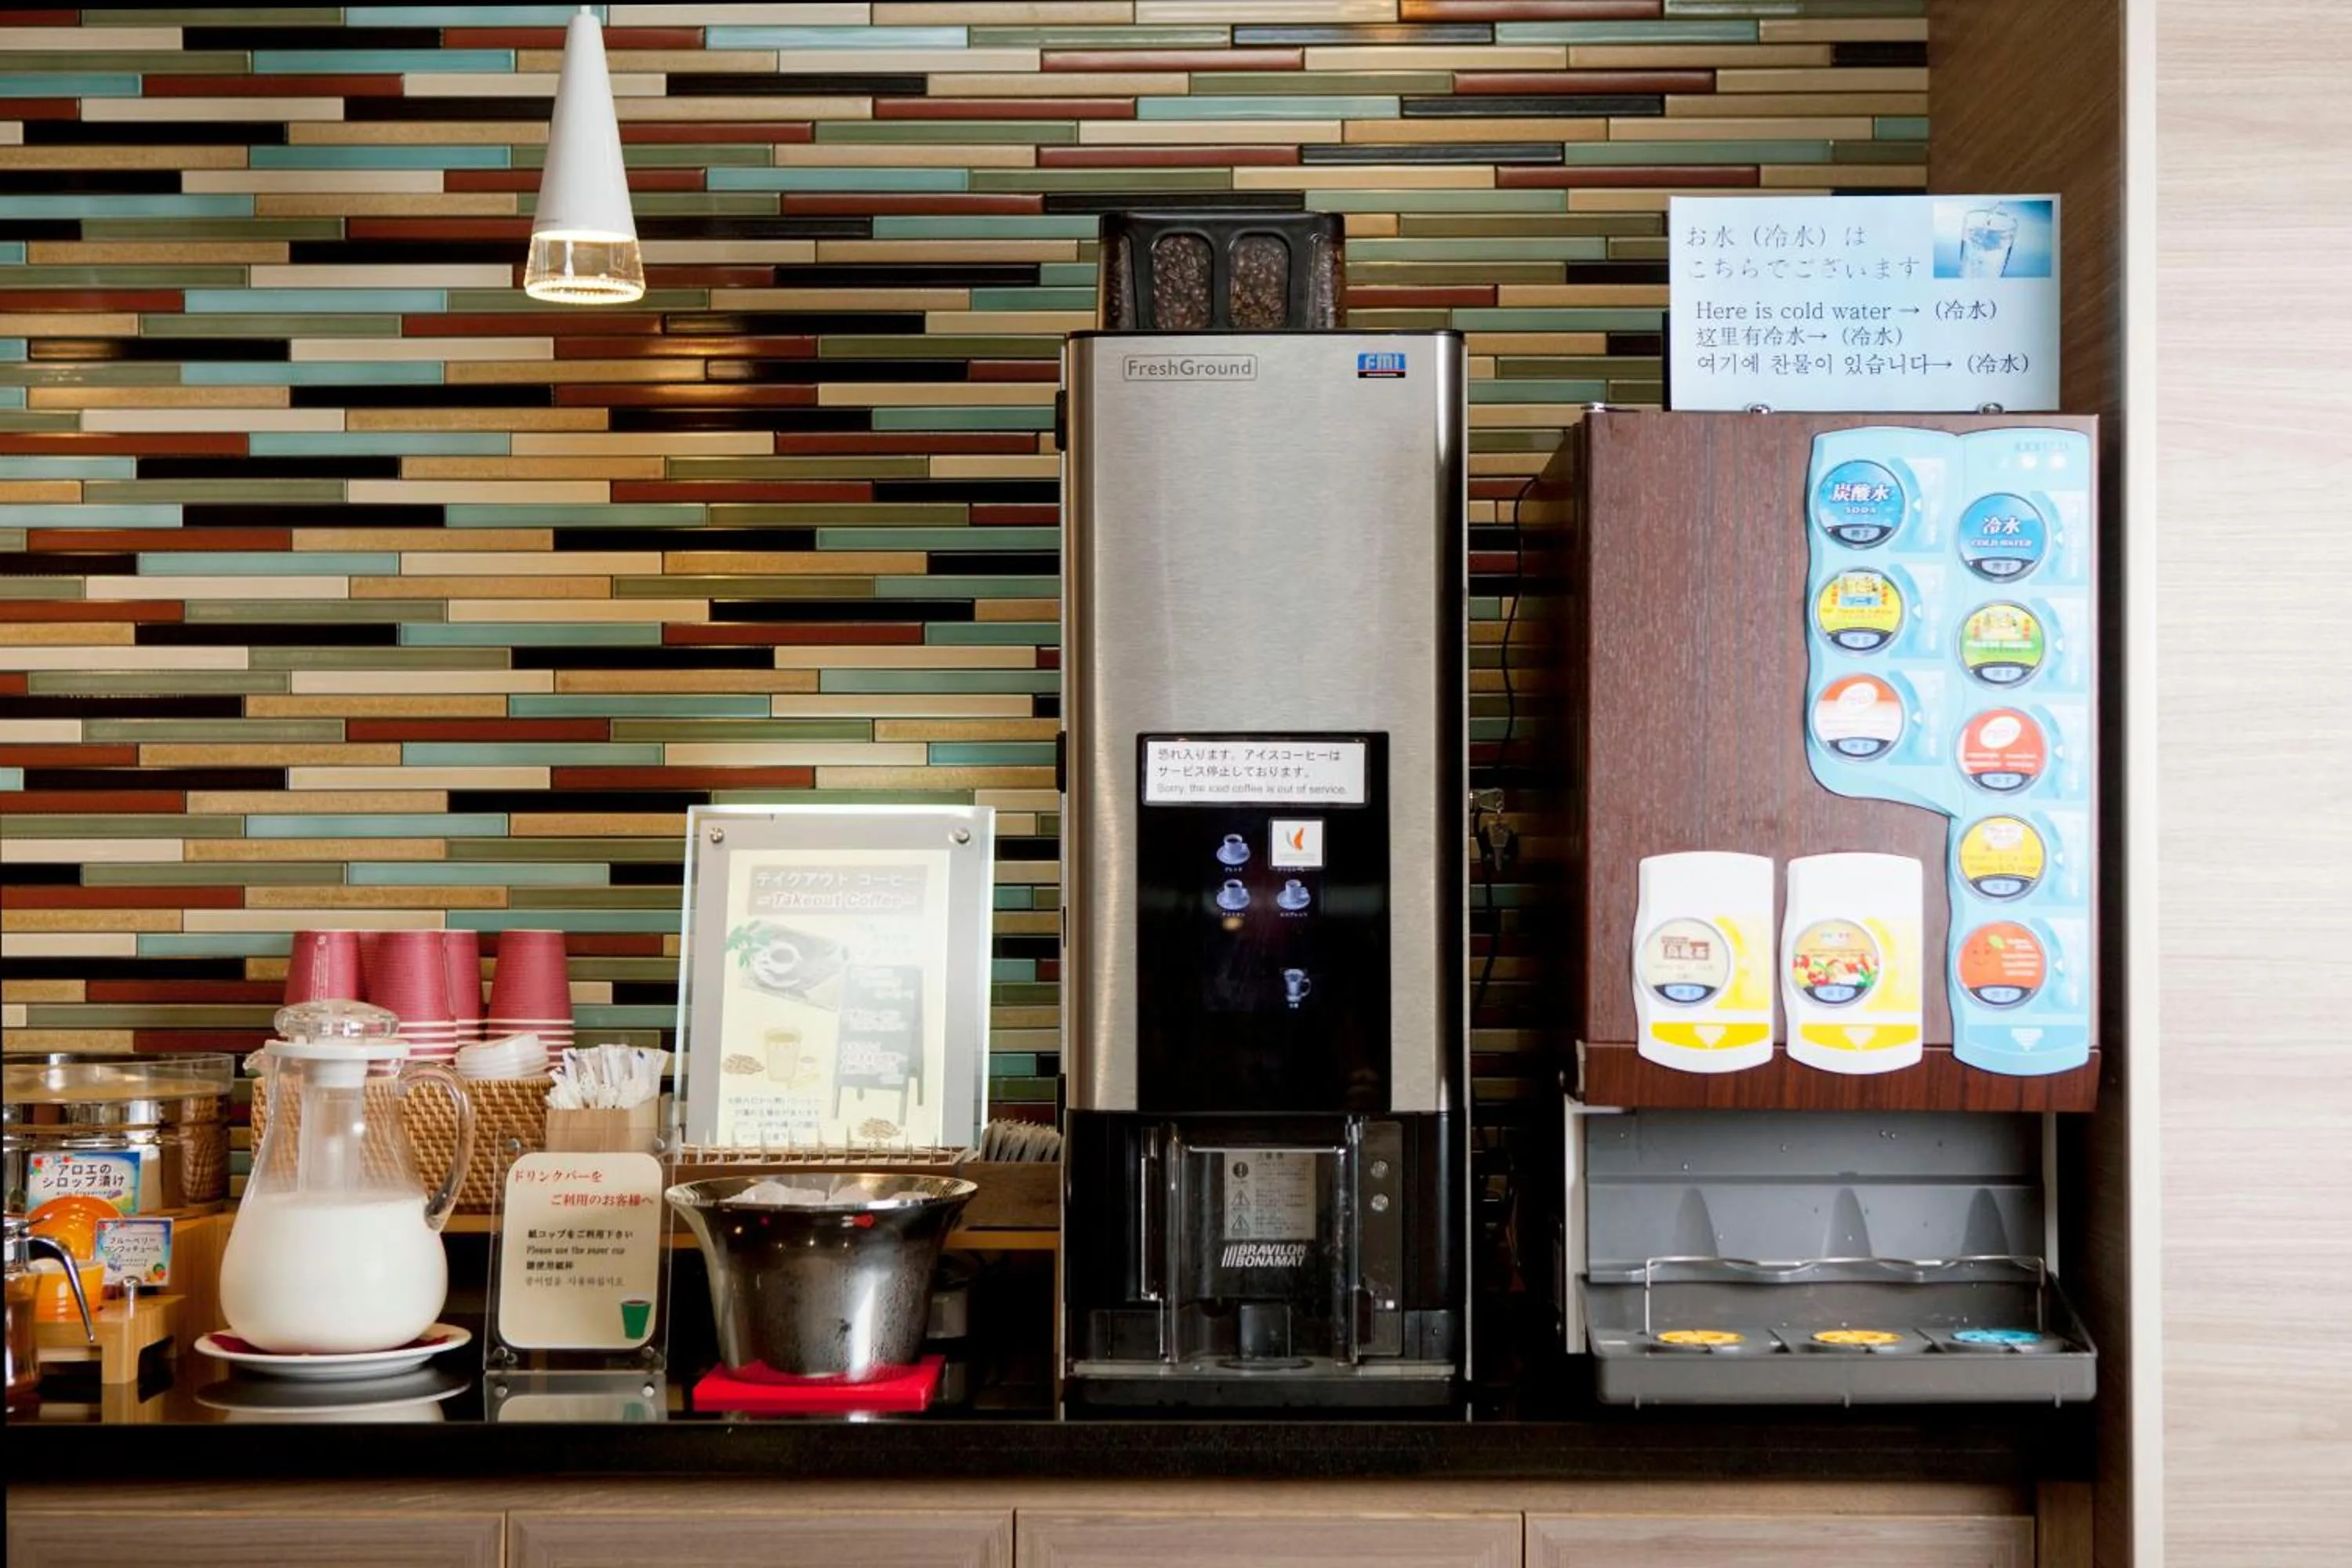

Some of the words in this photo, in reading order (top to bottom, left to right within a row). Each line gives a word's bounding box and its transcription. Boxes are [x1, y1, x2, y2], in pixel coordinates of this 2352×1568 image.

[1690, 256, 1920, 279] こちらでございます
[1697, 300, 1748, 320] Here
[1755, 301, 1773, 320] is
[1780, 301, 1824, 320] cold
[1831, 305, 1892, 320] water
[1696, 325, 1806, 347] 这里有冷水
[1127, 359, 1251, 376] FreshGround
[1697, 353, 1759, 375] 여기에
[1770, 353, 1833, 376] 찬물이
[1845, 353, 1927, 376] 있습니다
[1982, 515, 2020, 536] 冷水
[1189, 784, 1205, 793] the
[1232, 784, 1263, 793] coffee
[1267, 785, 1275, 793] is
[1277, 785, 1293, 794] out
[1296, 785, 1307, 794] of
[58, 1164, 111, 1175] アロエの
[514, 1170, 603, 1182] ドリンクバーを
[551, 1193, 654, 1207] ご利用のお客様へ
[1239, 1244, 1306, 1255] BRAVILOR
[1236, 1255, 1305, 1267] BONAMAT
